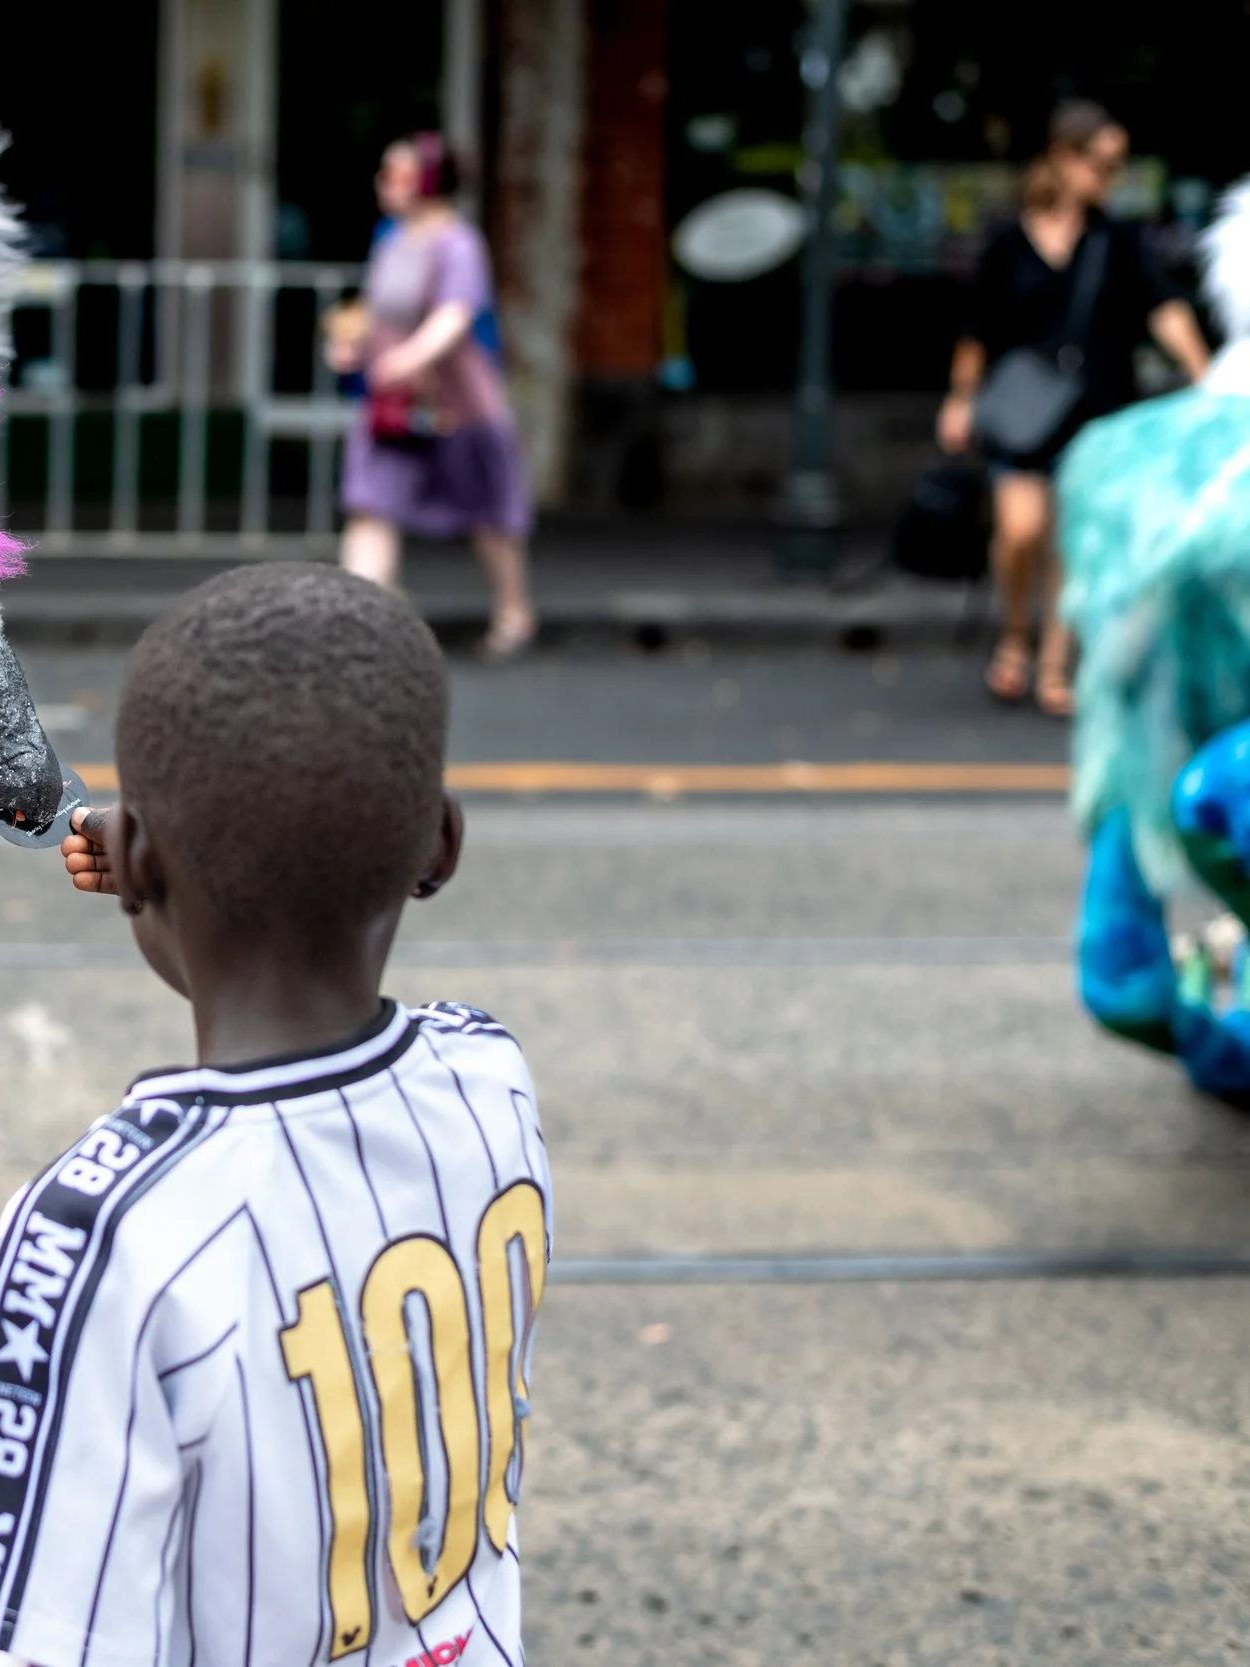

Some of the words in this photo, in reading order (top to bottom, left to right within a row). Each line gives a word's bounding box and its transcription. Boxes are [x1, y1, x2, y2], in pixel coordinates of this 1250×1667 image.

[57, 1128, 140, 1196] 28
[3, 1210, 87, 1329] MM
[278, 1177, 546, 1662] 100
